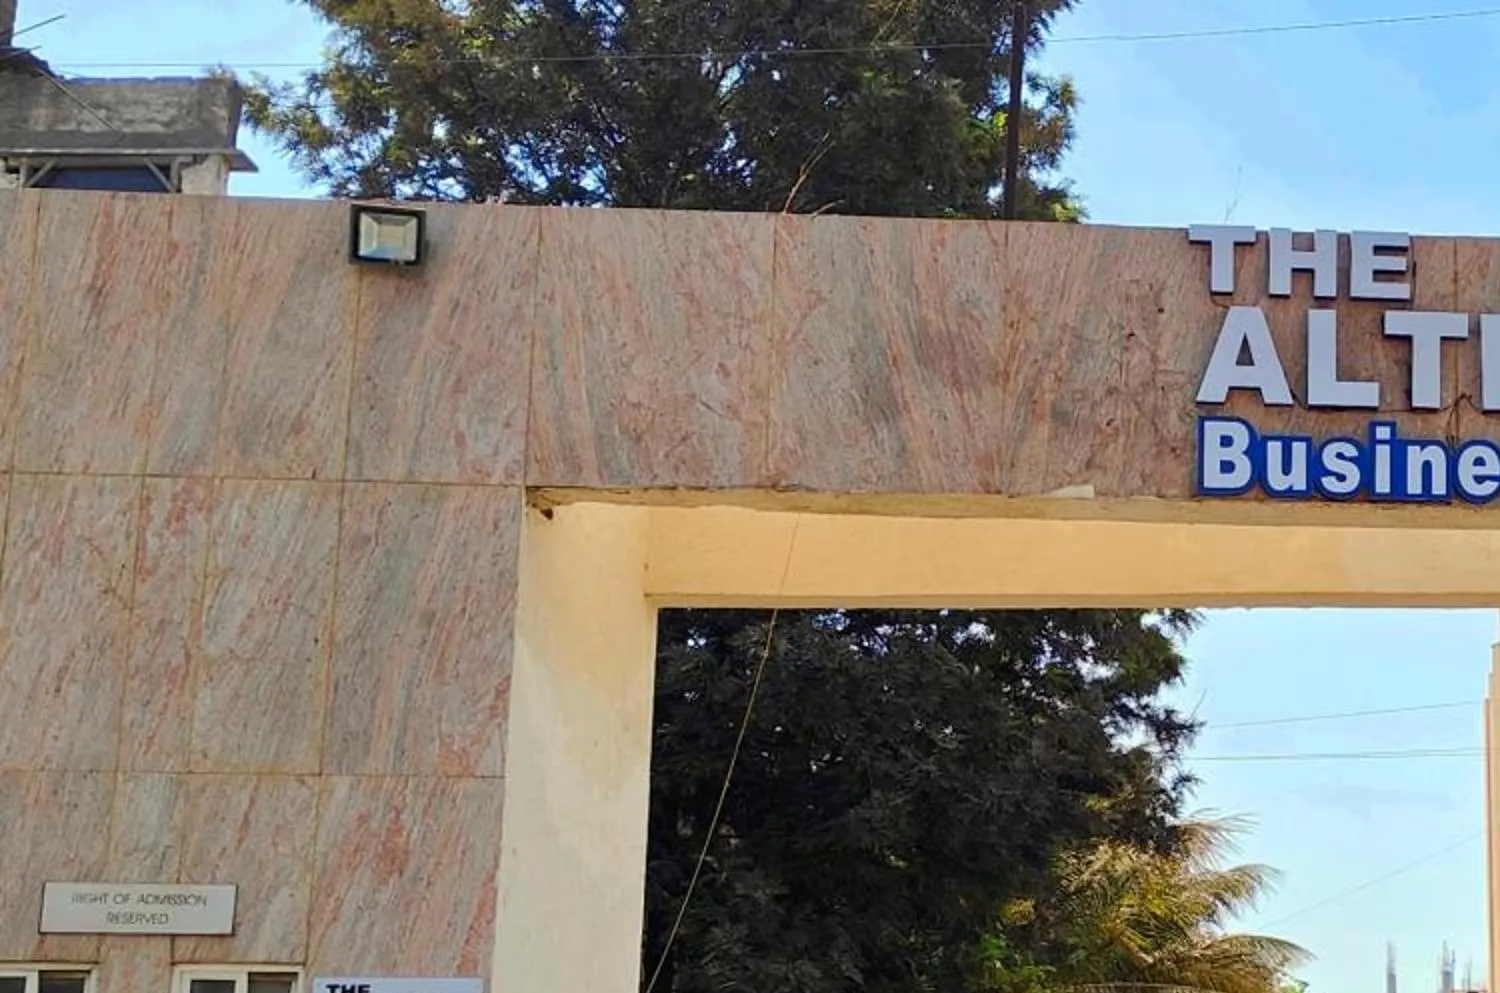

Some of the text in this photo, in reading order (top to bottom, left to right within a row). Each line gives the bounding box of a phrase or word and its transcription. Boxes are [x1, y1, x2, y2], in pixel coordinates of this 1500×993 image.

[1188, 223, 1413, 300] THE
[71, 893, 207, 906] RIGHT OF ADMISSION
[106, 911, 169, 925] RESERVED
